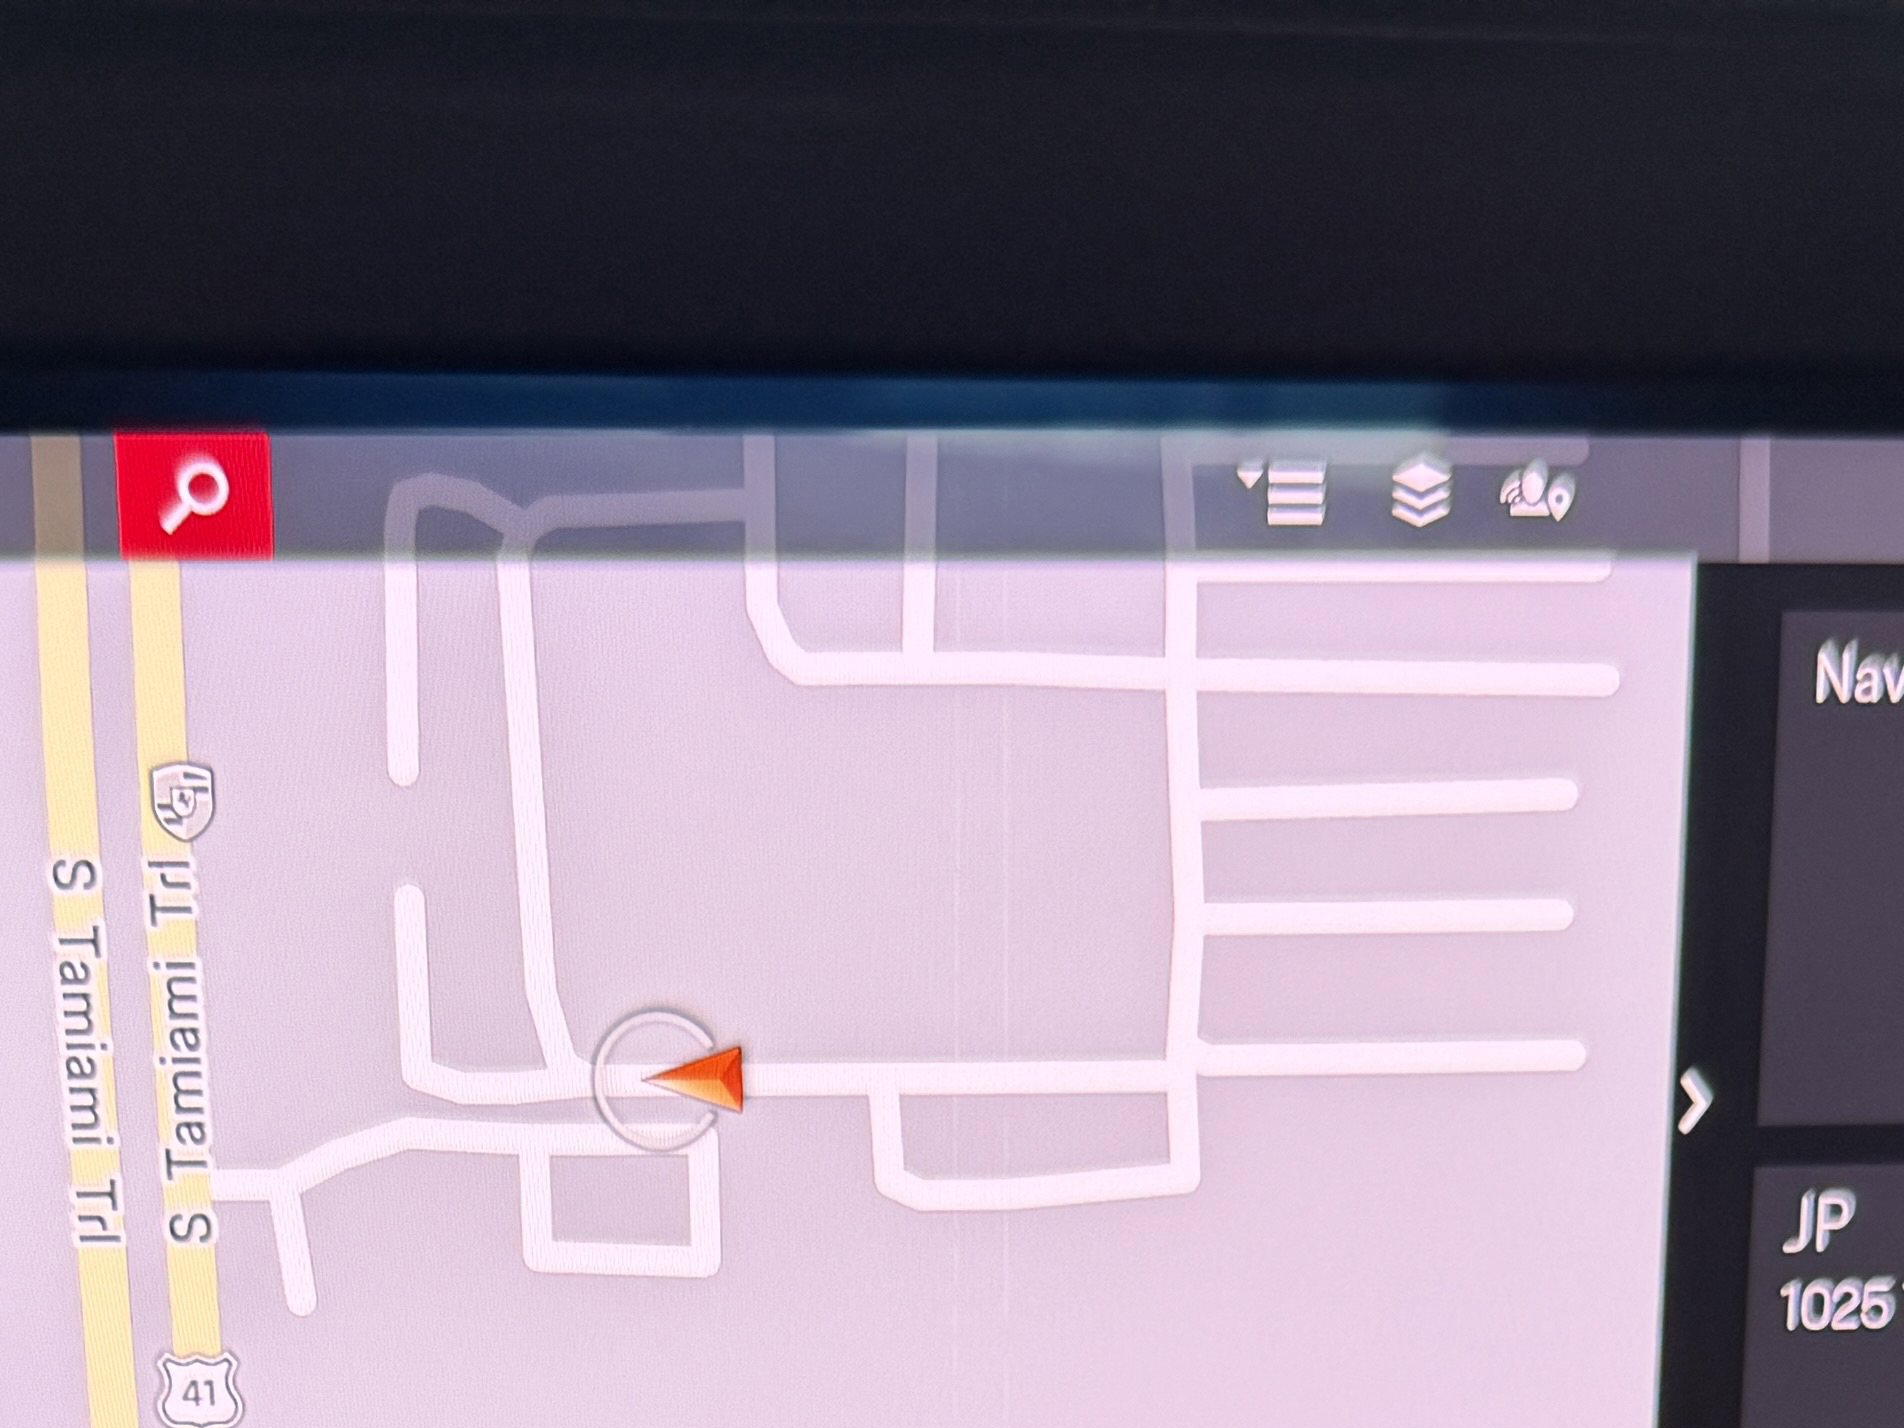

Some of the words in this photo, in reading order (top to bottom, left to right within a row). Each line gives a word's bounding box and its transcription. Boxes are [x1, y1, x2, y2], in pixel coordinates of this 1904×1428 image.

[53, 860, 96, 890] S
[146, 858, 194, 930] Trl
[54, 925, 114, 1150] Tamiami
[152, 958, 212, 1182] Tamiami
[71, 1178, 123, 1244] Trl
[169, 1210, 212, 1243] S
[1781, 1188, 1856, 1255] JP
[1780, 1278, 1895, 1332] 1025
[181, 1380, 217, 1408] 41
